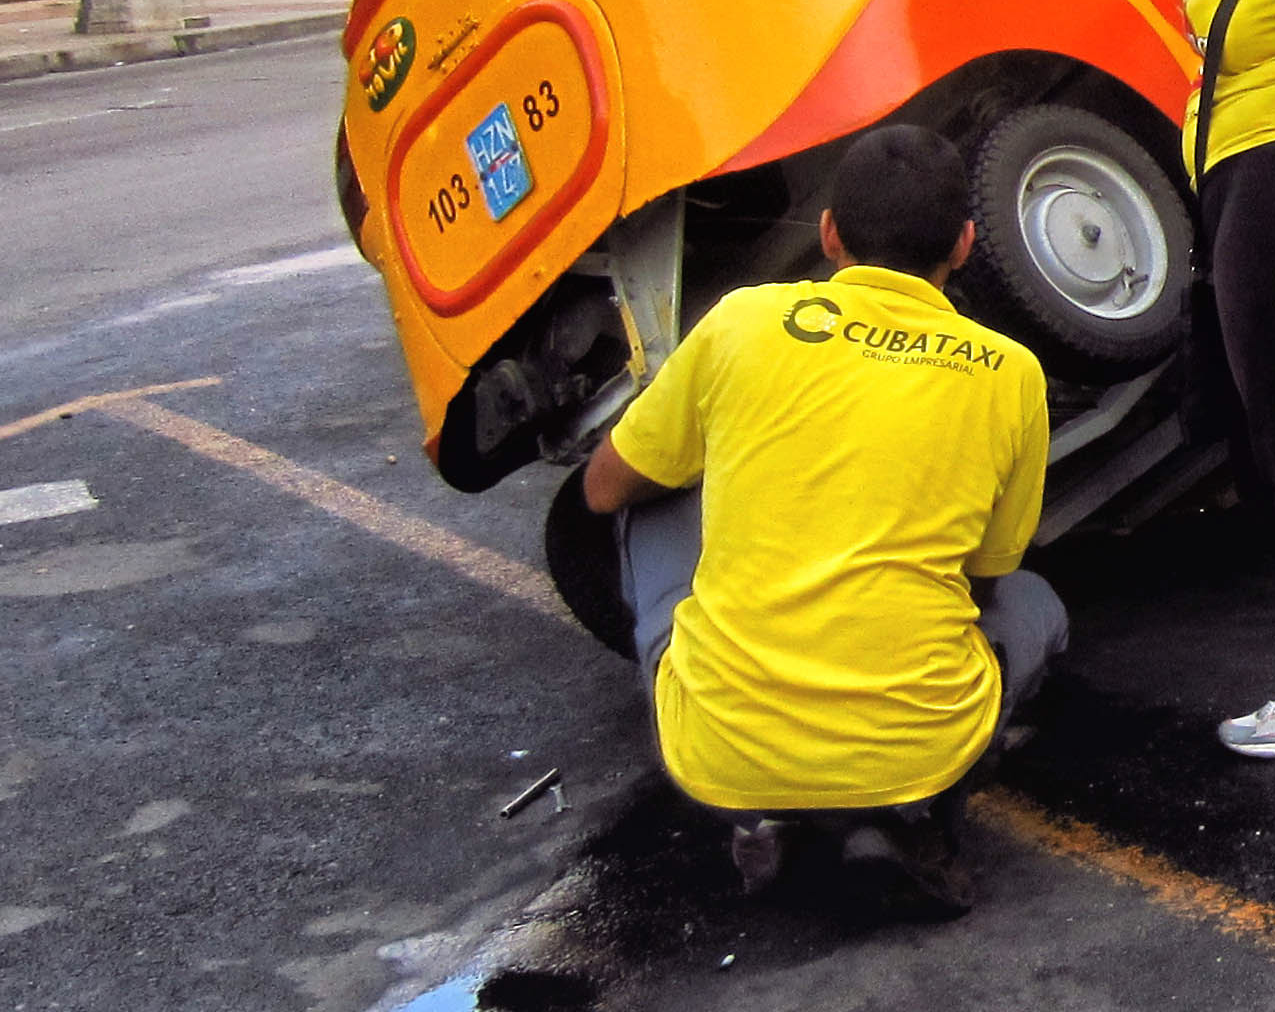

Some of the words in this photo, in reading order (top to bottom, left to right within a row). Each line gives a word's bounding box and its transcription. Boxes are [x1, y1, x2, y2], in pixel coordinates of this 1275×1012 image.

[522, 80, 560, 132] 83
[471, 112, 516, 171] HZN
[428, 174, 470, 234] 103
[843, 321, 1005, 372] CUBATAXI
[862, 349, 900, 364] GRUPO
